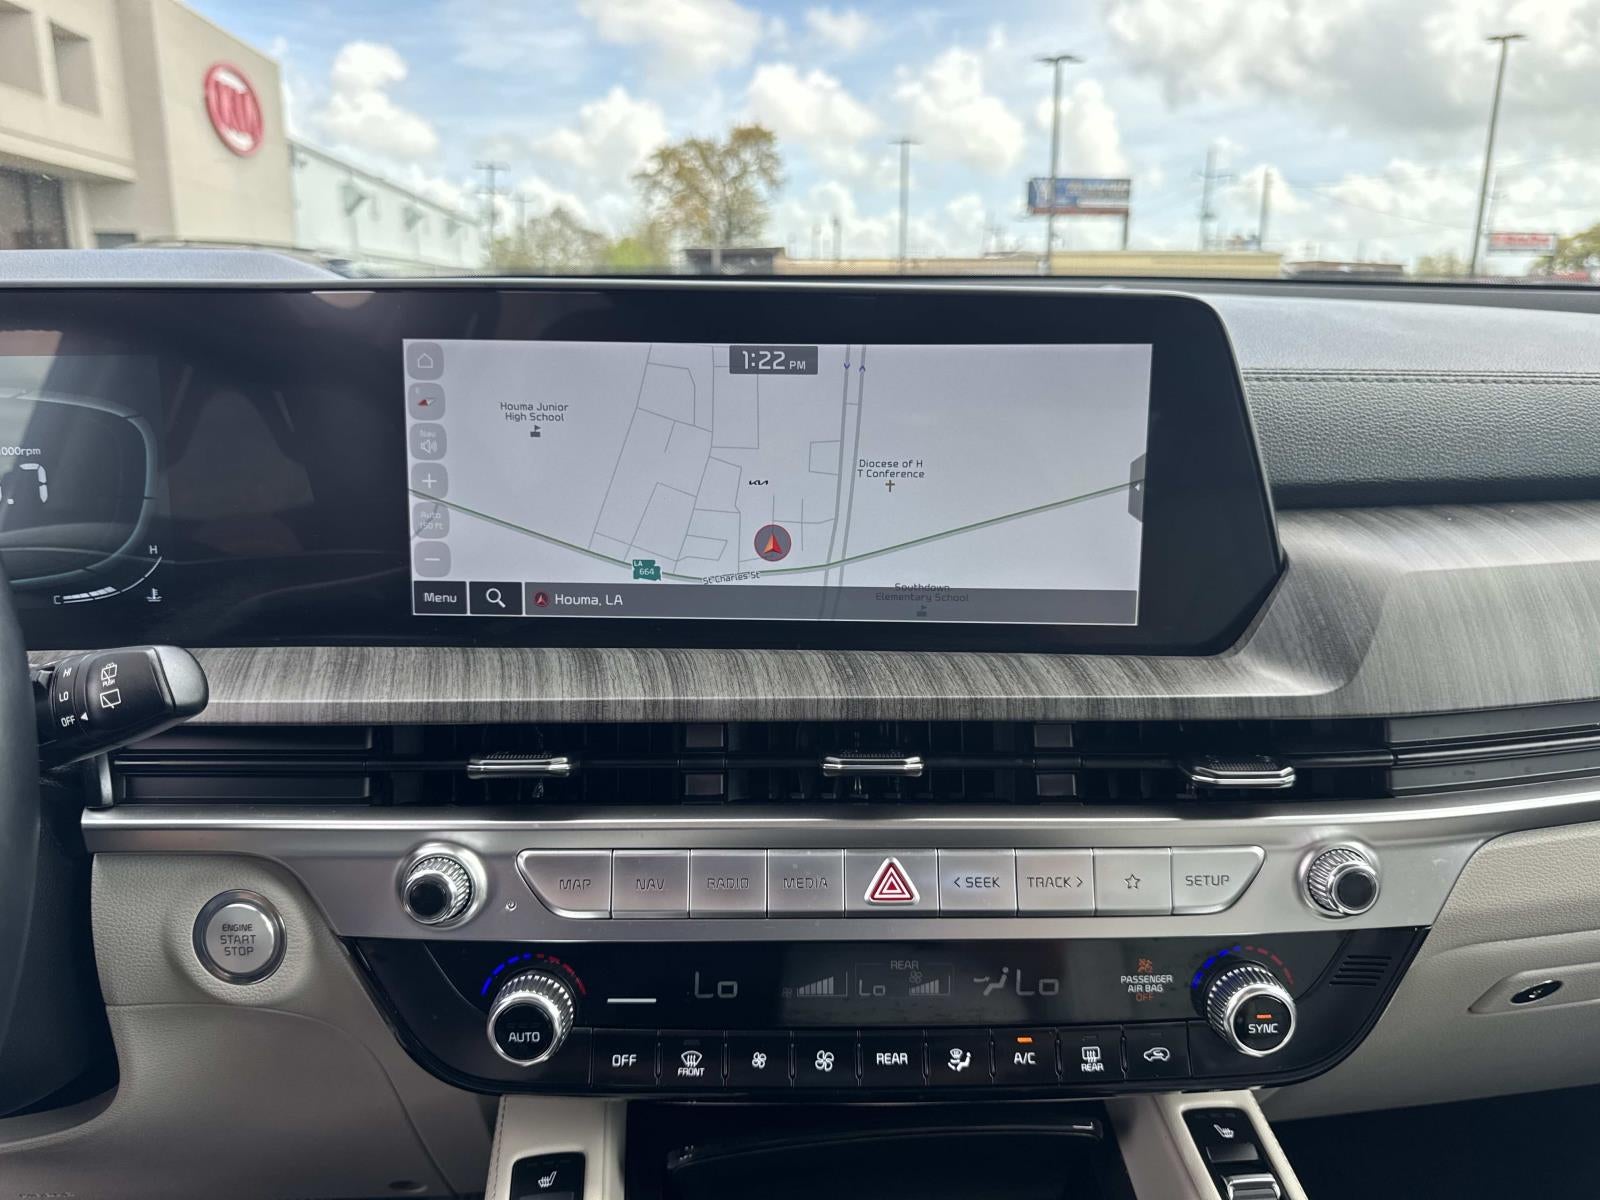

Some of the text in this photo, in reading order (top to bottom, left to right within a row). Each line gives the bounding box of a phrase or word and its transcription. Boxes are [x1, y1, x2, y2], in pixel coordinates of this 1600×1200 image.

[741, 350, 806, 371] 1:22 PM
[500, 402, 569, 411] Houma Junior
[505, 412, 565, 422] High School
[859, 459, 924, 468] Diocese of H
[857, 469, 925, 479] T Conference
[149, 545, 158, 555] H
[639, 567, 655, 576] 664
[702, 570, 761, 585] St Charles St
[894, 582, 951, 592] Southdown
[423, 592, 458, 604] Menu
[554, 593, 624, 607] Houma, LA
[875, 592, 970, 603] Elementary School
[63, 667, 73, 678] HI
[58, 691, 69, 702] LO
[60, 715, 76, 728] OFF
[559, 879, 592, 891] MAP
[636, 878, 665, 891] NAV
[707, 877, 750, 889] RADIO
[783, 876, 829, 890] MEDIA
[965, 876, 1000, 889] SEEK
[1027, 876, 1073, 889] TRACK
[1185, 874, 1231, 887] SETUP
[222, 923, 254, 932] ENGINE
[220, 934, 257, 945] START
[224, 946, 254, 956] STOP
[890, 960, 919, 970] REAR
[1015, 968, 1060, 996] Lo
[1120, 974, 1173, 984] PASSENGER
[694, 971, 739, 999] Lo
[858, 979, 887, 996] Lo
[1127, 983, 1164, 993] AIR BAG
[1135, 992, 1153, 1001] OFF
[1247, 1023, 1279, 1034] SYNC
[508, 1031, 540, 1043] AUTO
[611, 1054, 637, 1067] OFF
[876, 1052, 908, 1065] REAR
[1013, 1051, 1036, 1065] A/C
[677, 1067, 705, 1077] FRONT
[1080, 1063, 1104, 1072] REAR
